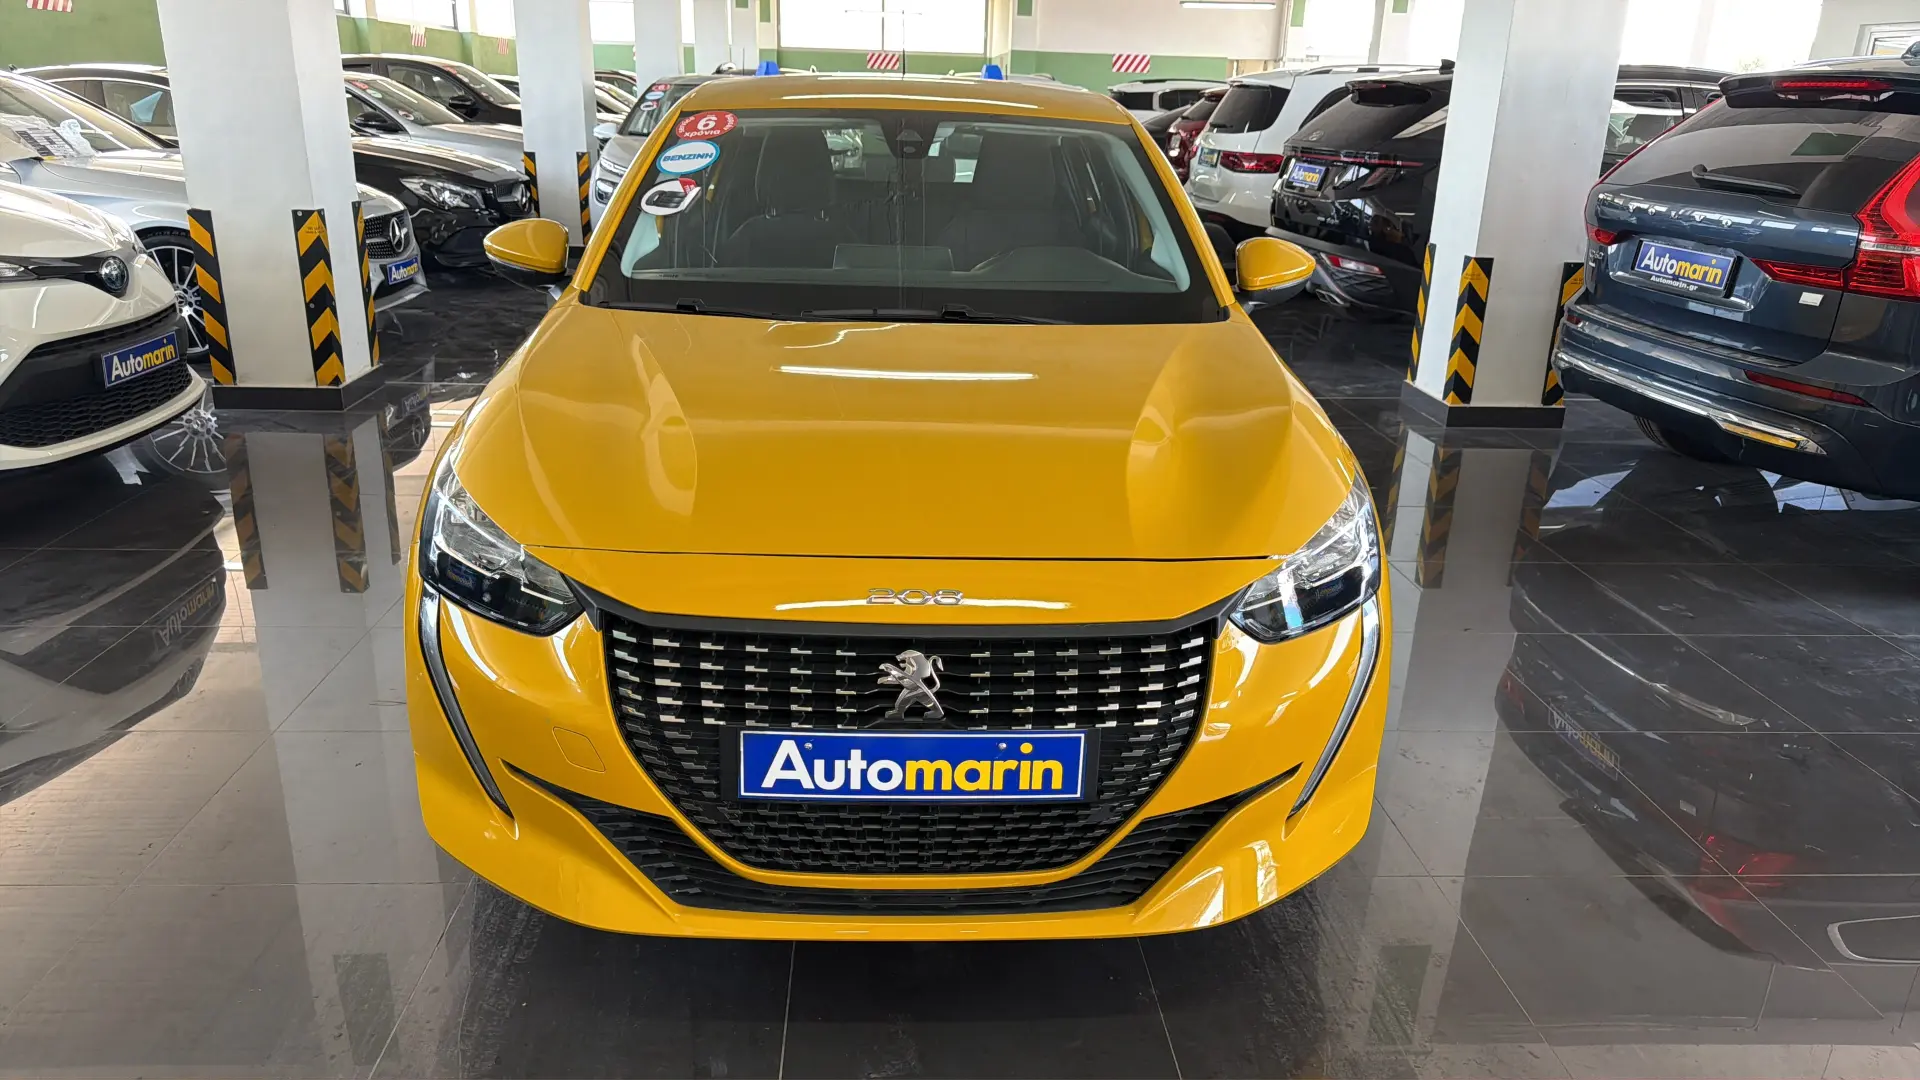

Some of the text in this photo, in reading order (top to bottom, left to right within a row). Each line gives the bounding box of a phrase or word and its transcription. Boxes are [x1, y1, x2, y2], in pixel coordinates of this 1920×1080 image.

[697, 116, 718, 130] 6
[1640, 246, 1722, 284] Automarin
[1650, 275, 1699, 291] Automarin.gr
[111, 338, 176, 381] Automarin
[866, 588, 964, 605] 208
[760, 739, 1064, 791] Automarin
